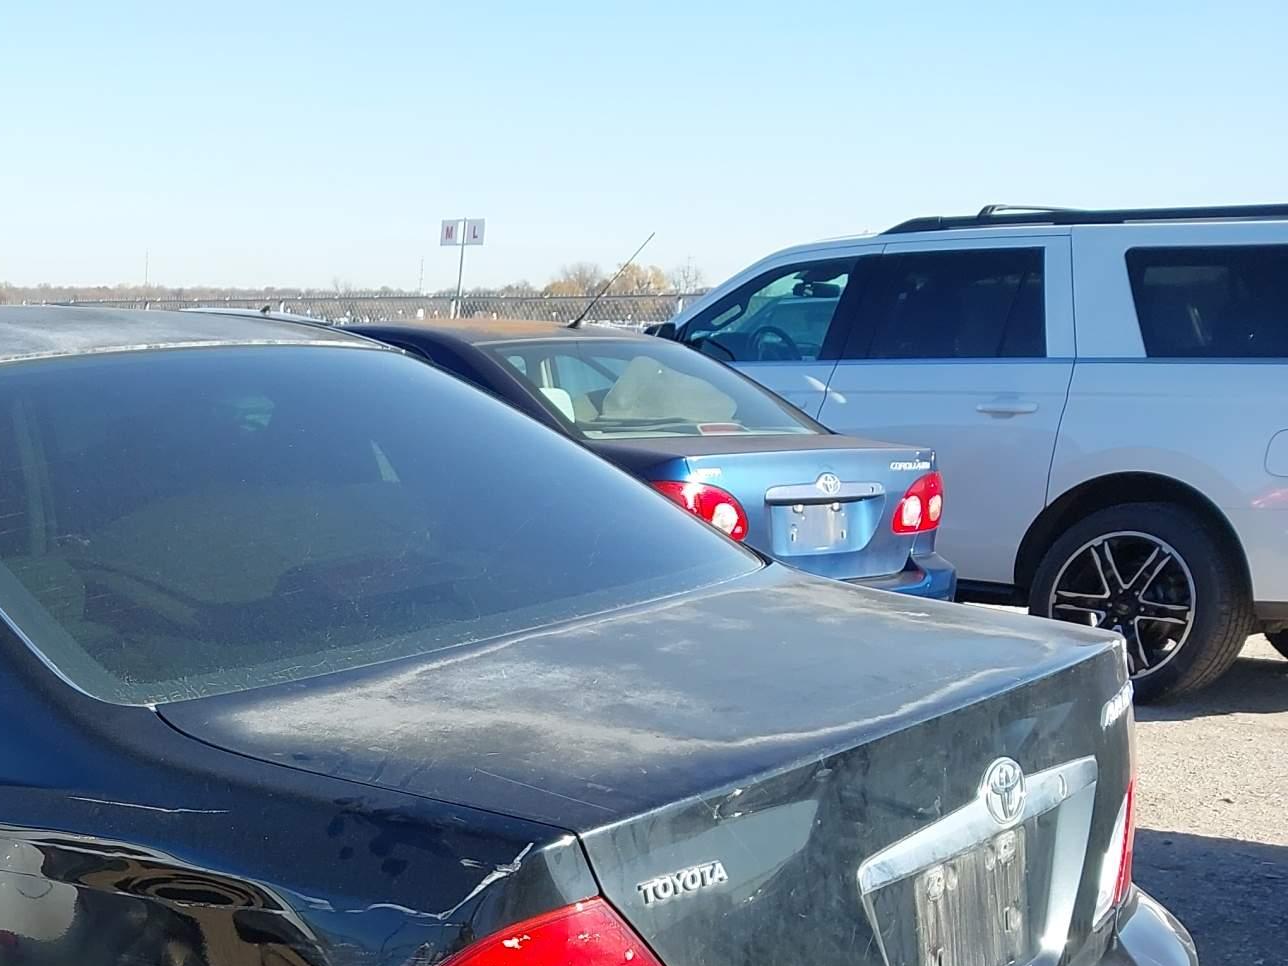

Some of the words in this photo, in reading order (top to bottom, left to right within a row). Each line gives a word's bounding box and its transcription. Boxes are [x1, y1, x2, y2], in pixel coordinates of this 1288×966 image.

[445, 226, 453, 240] M
[472, 225, 478, 239] L
[636, 860, 728, 906] TOYOTA
